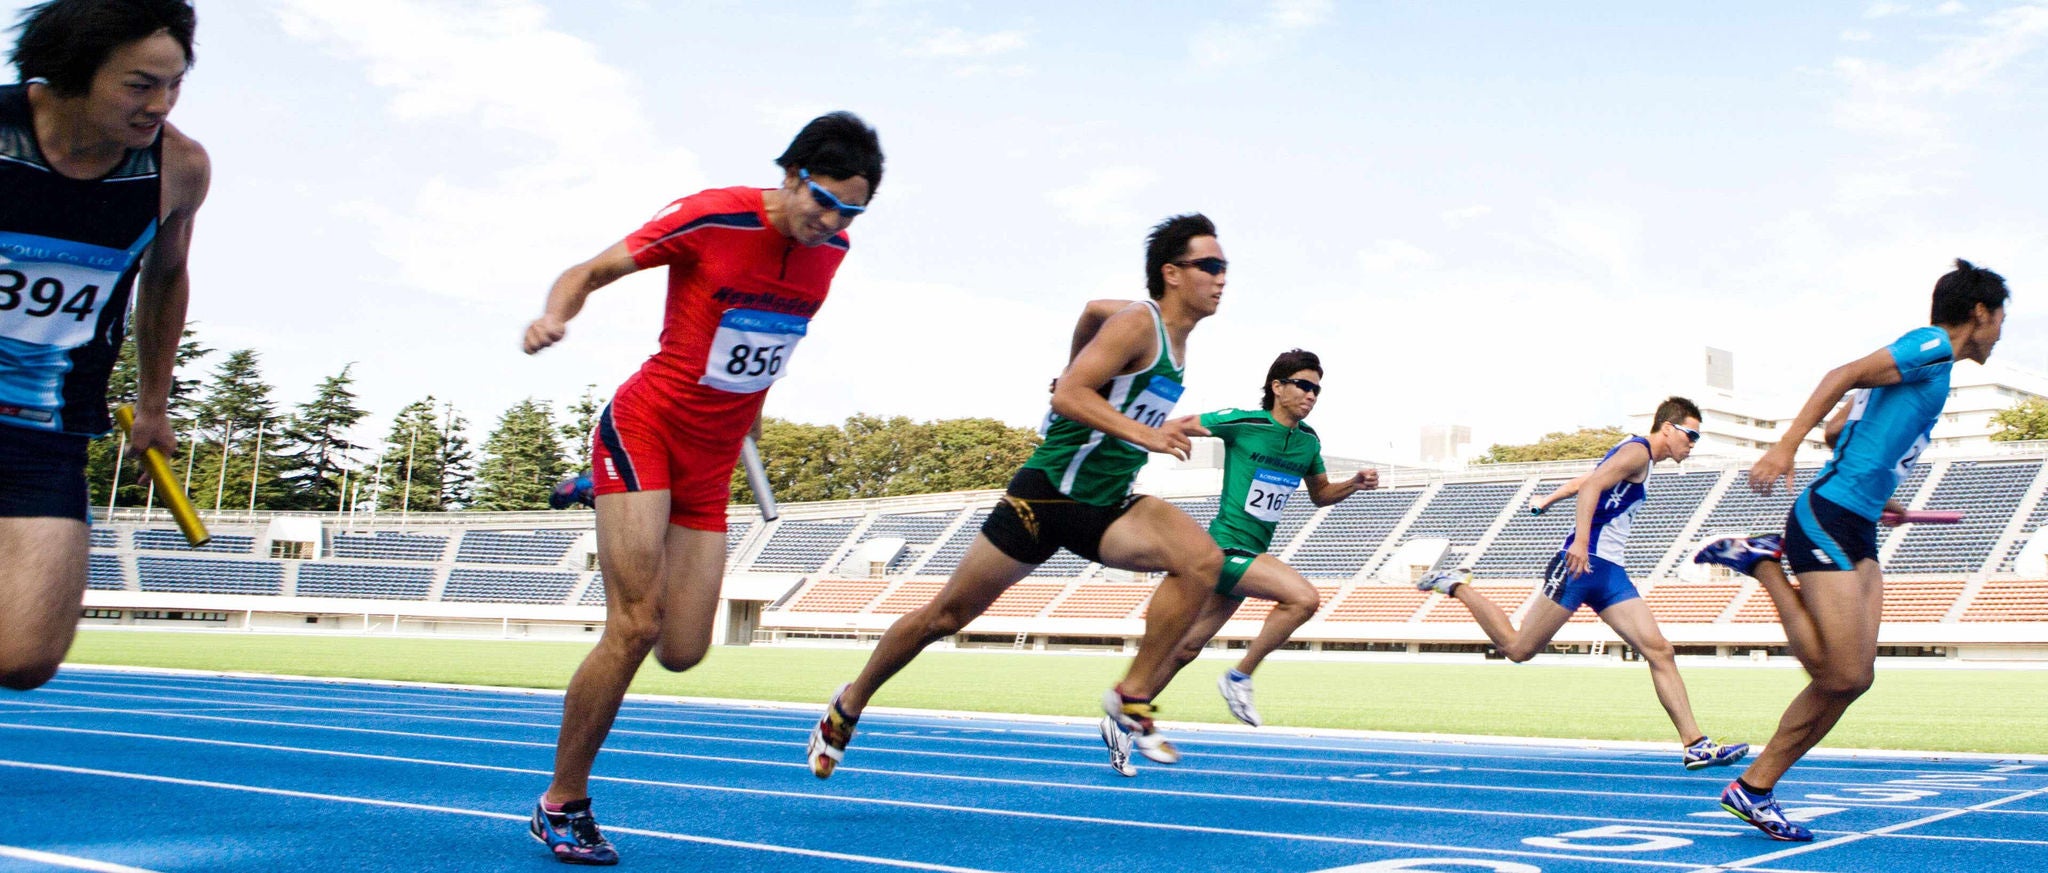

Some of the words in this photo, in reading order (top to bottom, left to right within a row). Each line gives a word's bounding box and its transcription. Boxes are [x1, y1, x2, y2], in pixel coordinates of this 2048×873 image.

[726, 344, 785, 376] 856
[1883, 774, 2008, 788] 2
[1804, 788, 1941, 802] 3
[1521, 825, 1744, 852] 5
